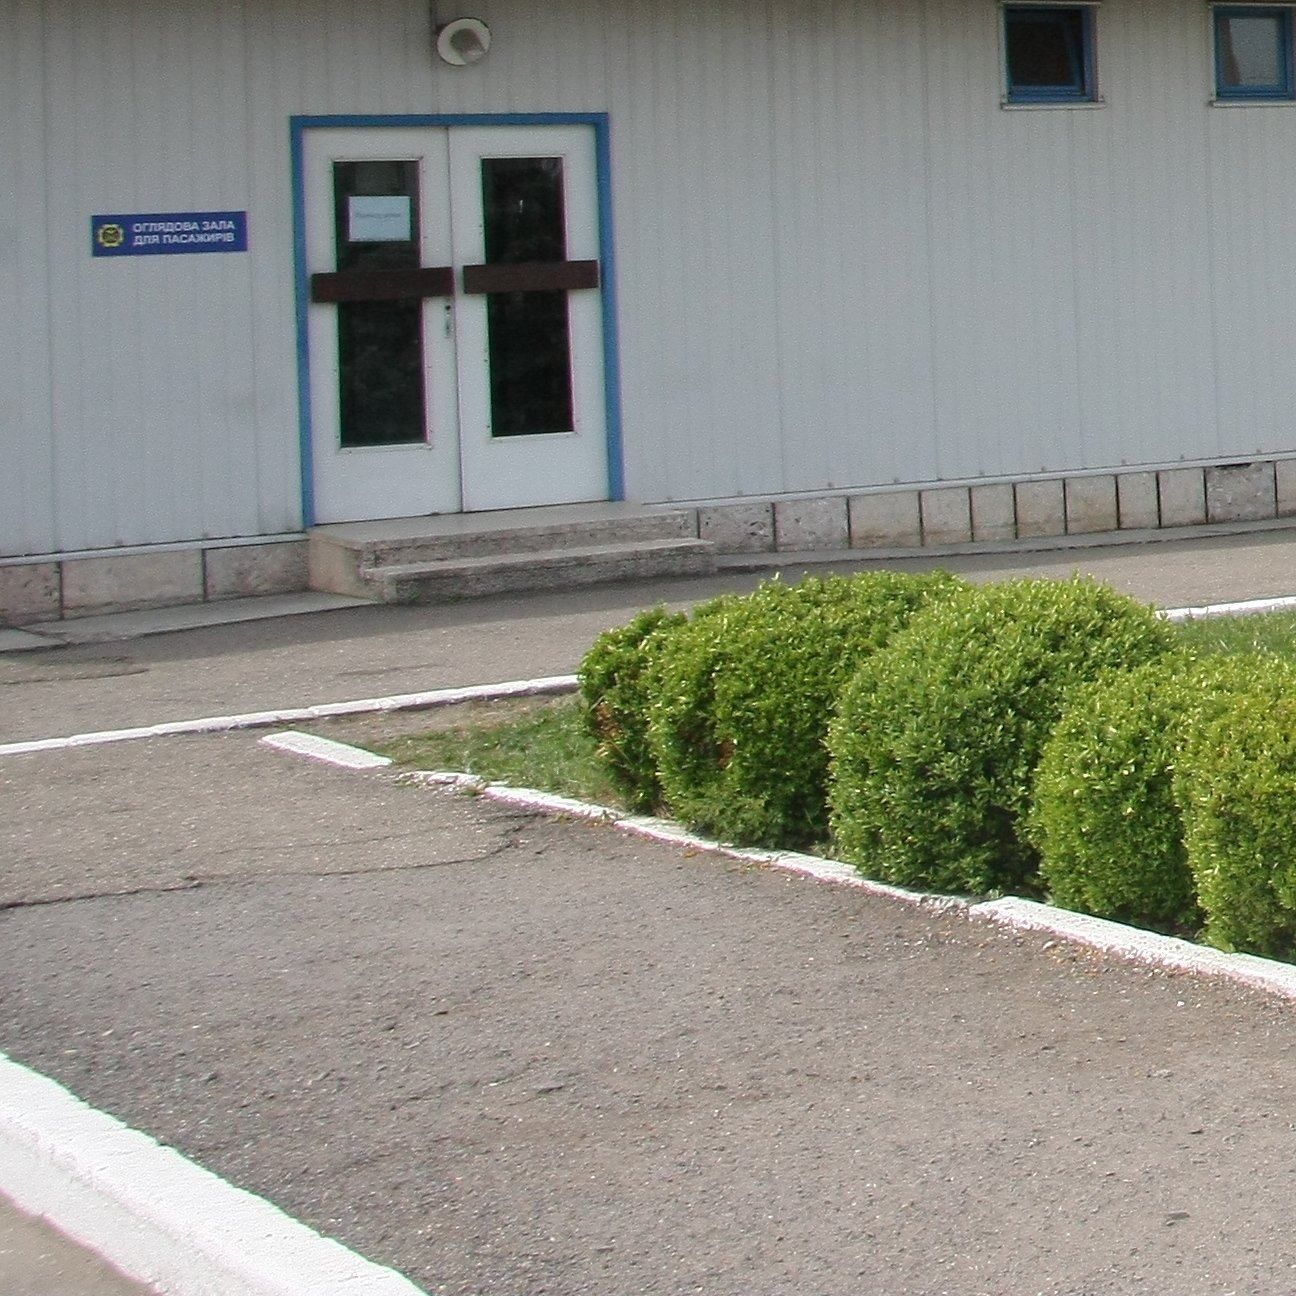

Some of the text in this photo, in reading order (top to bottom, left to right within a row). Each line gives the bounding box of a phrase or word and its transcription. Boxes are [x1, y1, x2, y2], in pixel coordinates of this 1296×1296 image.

[133, 221, 235, 233] ОГЛЯДОВА ЗАЛА
[133, 232, 235, 246] ДЛЯ ПАСАЖИРІВ
